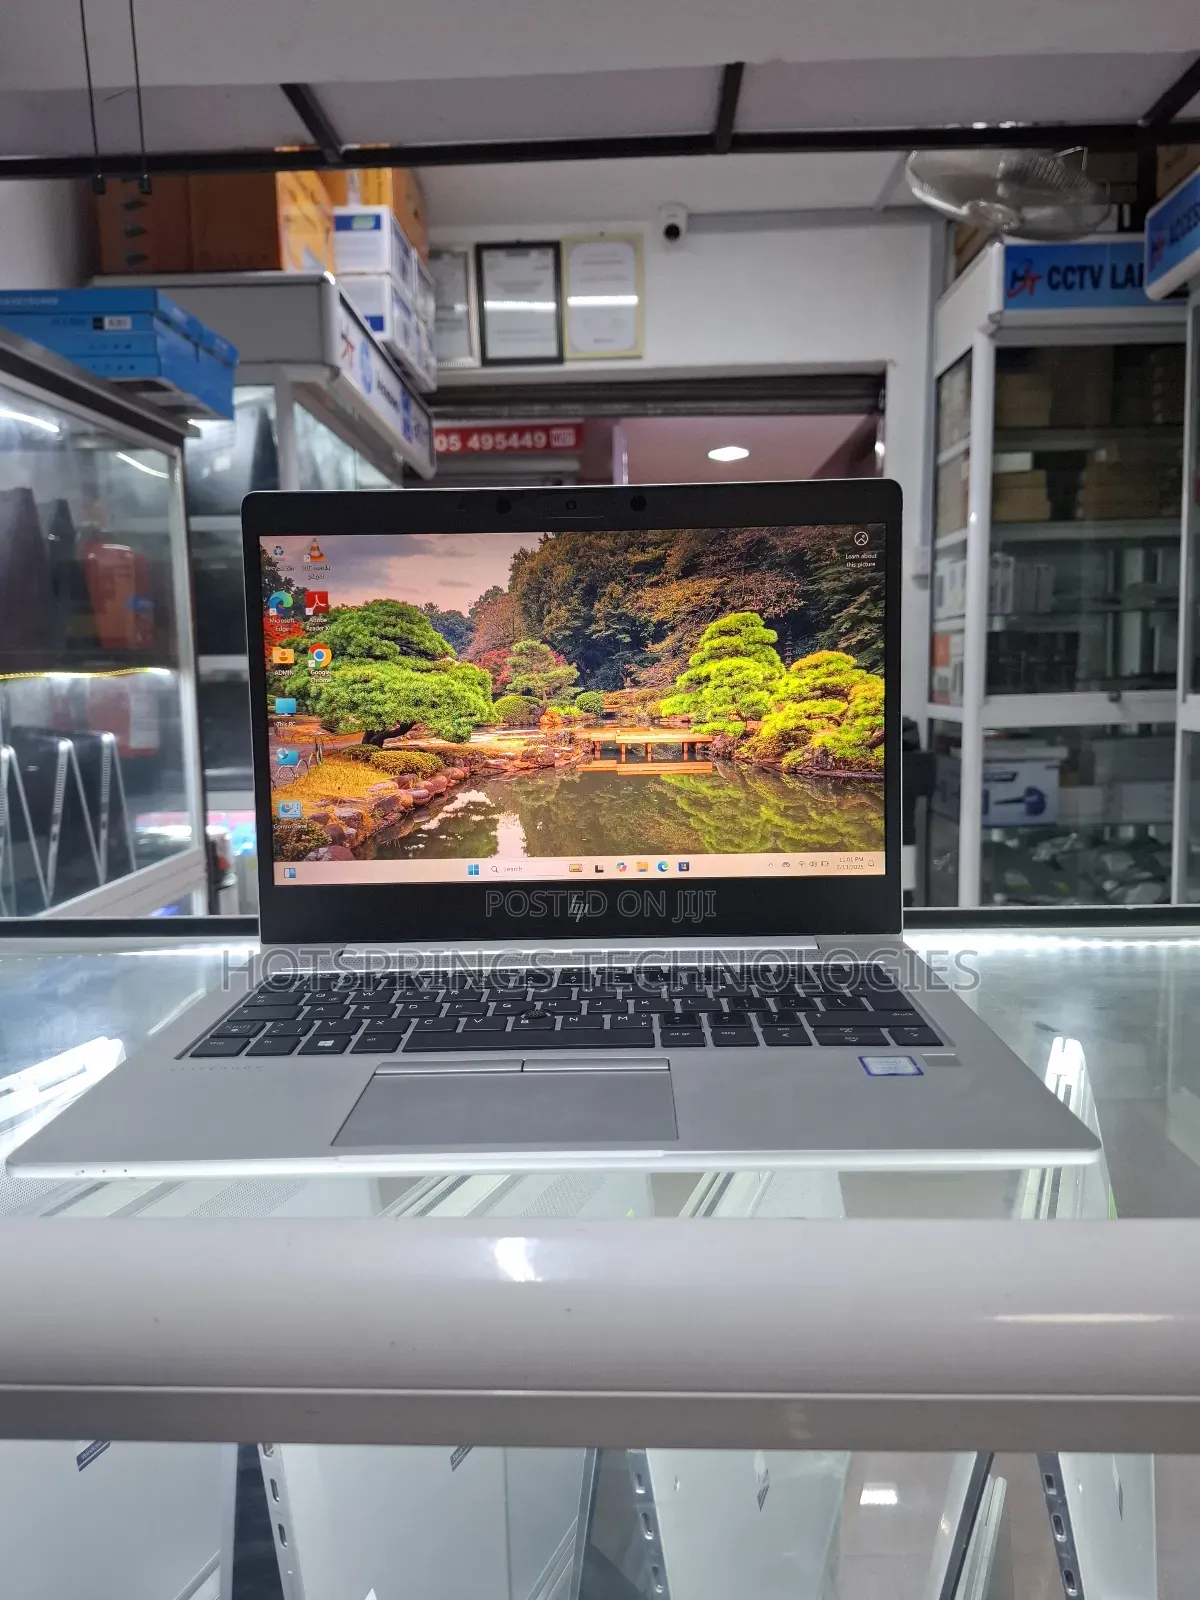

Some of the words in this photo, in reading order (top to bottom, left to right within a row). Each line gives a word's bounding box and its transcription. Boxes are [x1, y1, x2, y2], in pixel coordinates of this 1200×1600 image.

[1047, 264, 1104, 291] CCTV
[466, 431, 547, 450] 495449
[310, 669, 330, 677] Google
